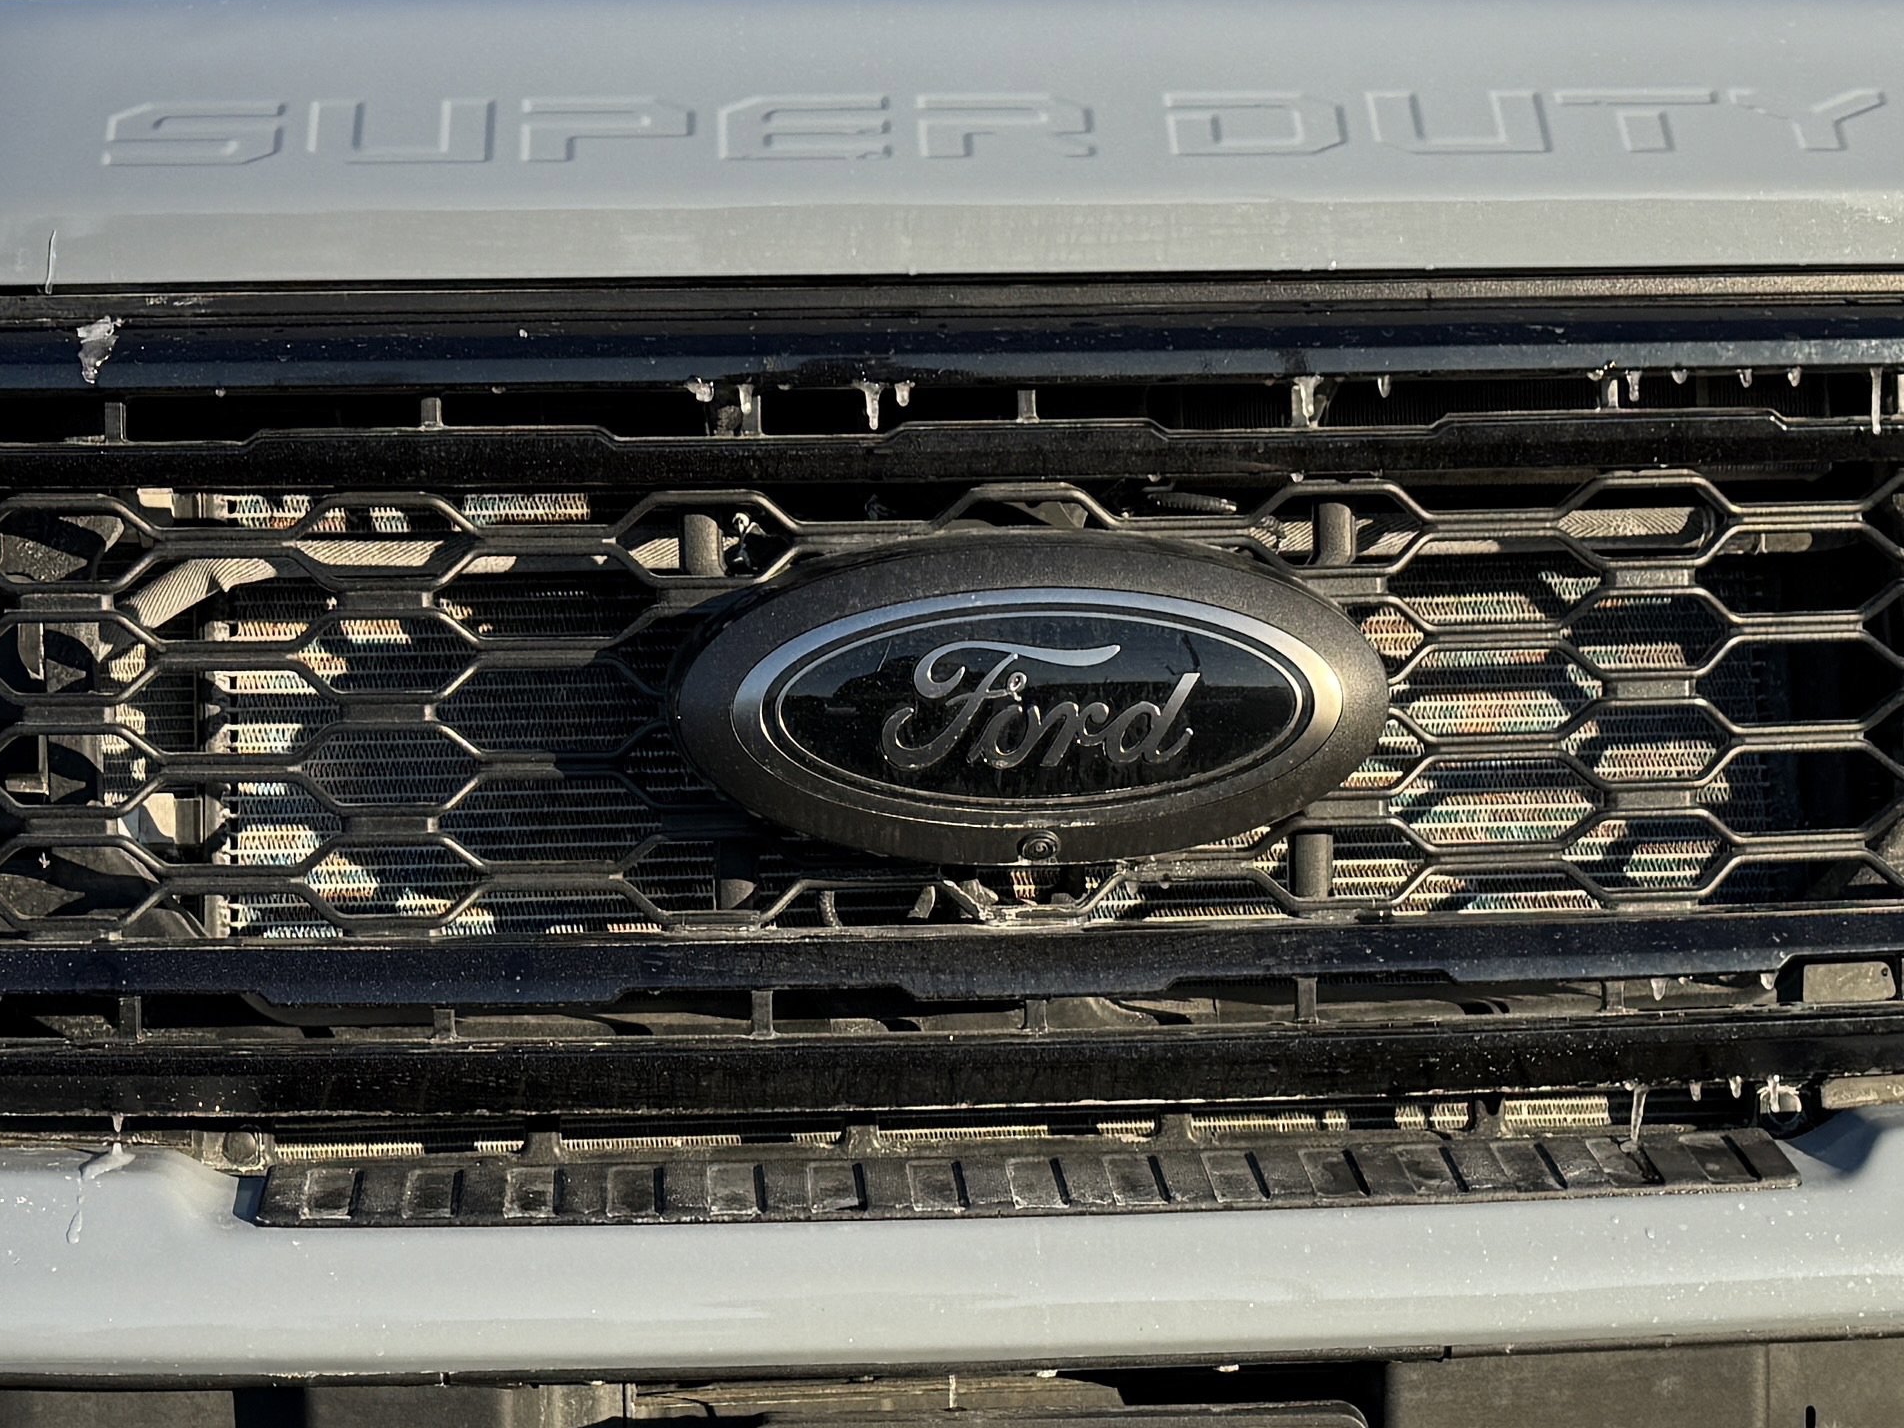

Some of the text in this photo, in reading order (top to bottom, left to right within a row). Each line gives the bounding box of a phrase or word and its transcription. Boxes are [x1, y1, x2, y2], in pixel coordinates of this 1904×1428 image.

[101, 88, 1886, 167] SUPER DUTY
[881, 640, 1201, 771] Ford
